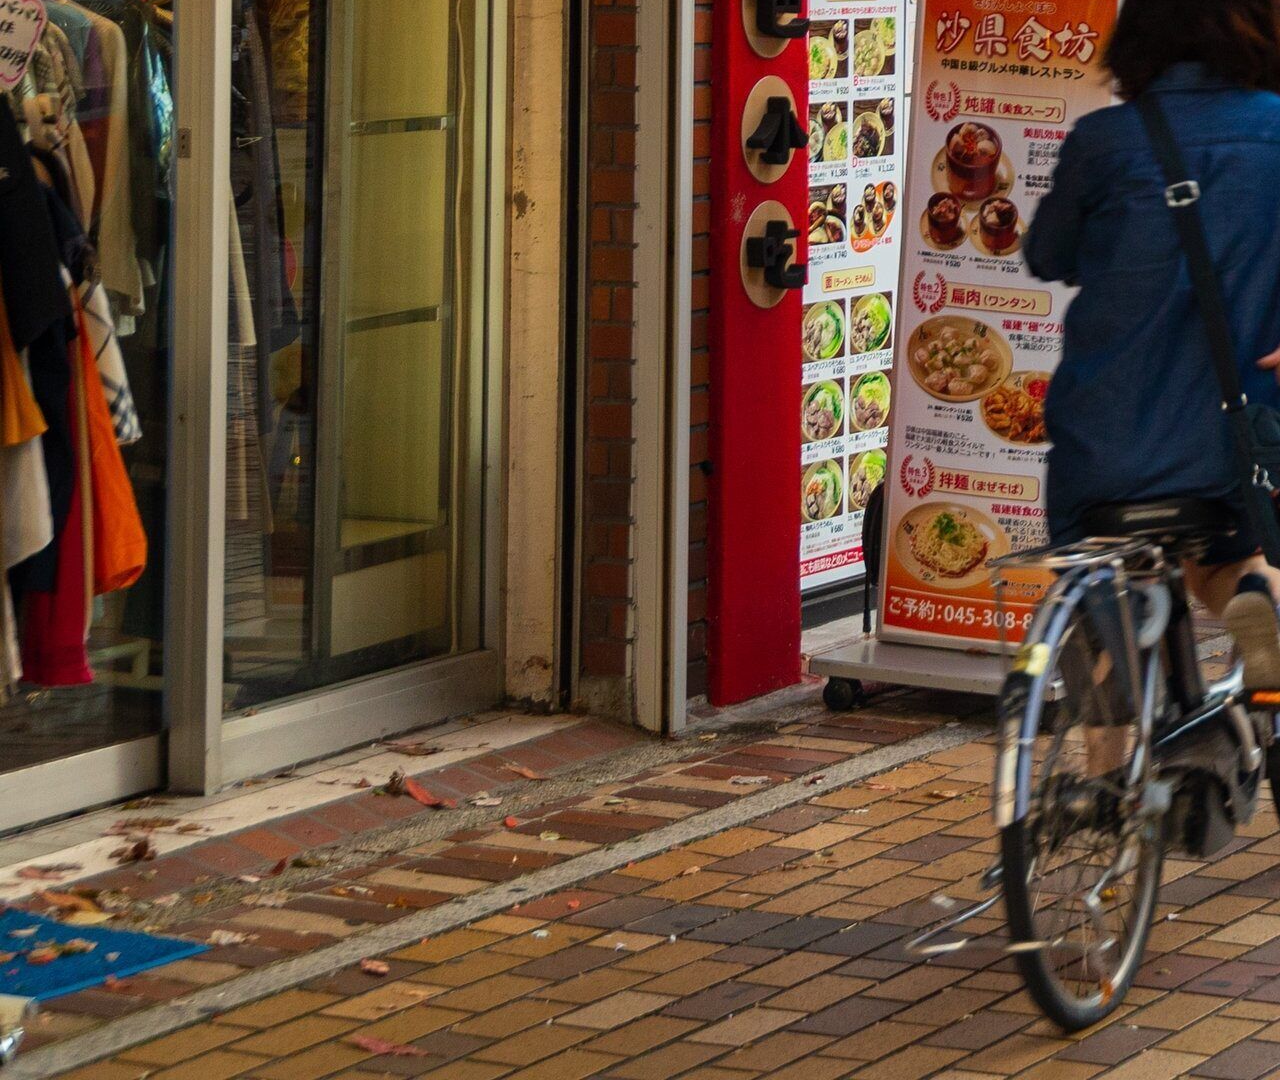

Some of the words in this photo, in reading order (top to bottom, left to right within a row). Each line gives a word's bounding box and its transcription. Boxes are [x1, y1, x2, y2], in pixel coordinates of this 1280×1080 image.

[936, 11, 1099, 64] 沙県食坊
[941, 58, 1086, 81] 中国B級グルメ中華レストラン
